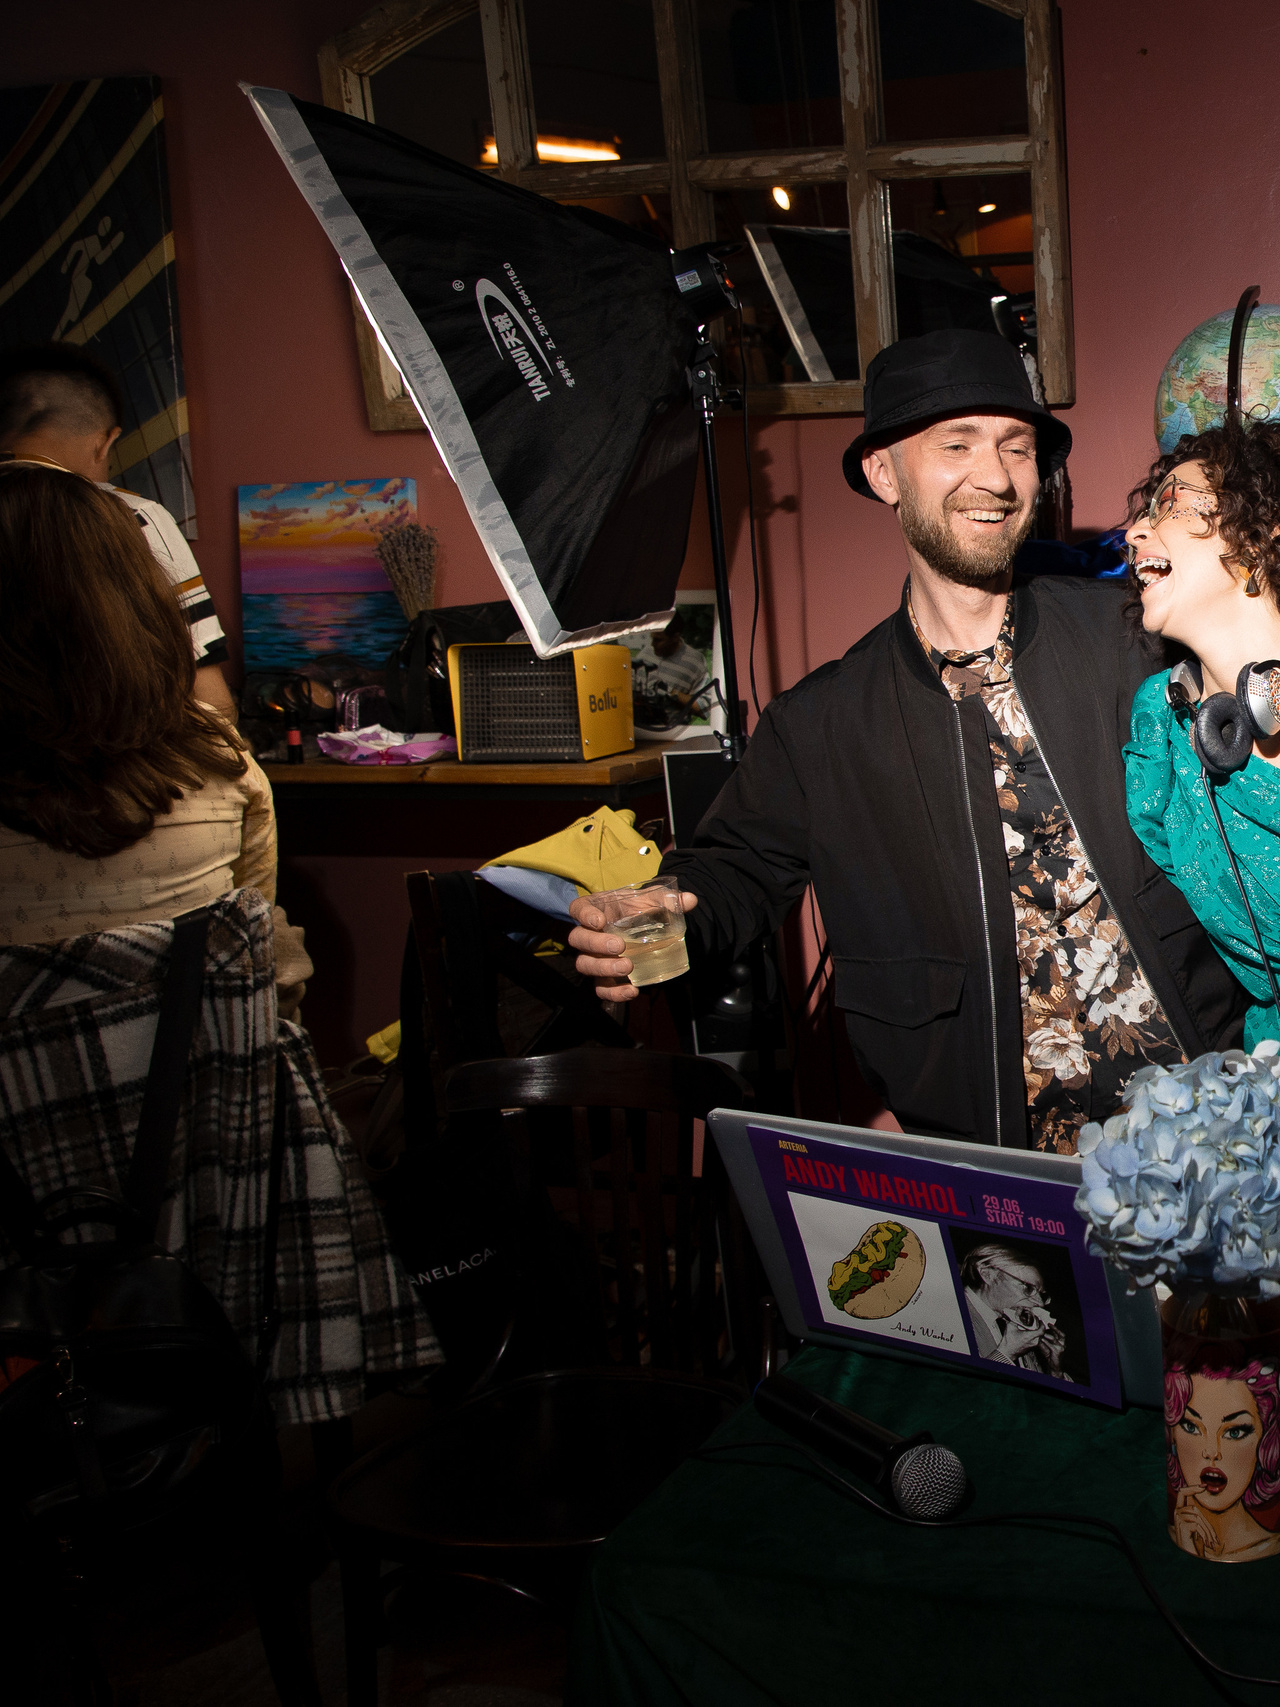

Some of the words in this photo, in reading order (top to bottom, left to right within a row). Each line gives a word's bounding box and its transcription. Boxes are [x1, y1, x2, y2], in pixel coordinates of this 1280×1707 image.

[532, 315, 549, 337] 2010
[588, 687, 618, 713] Ballu
[778, 1139, 808, 1154] ARTERIA
[782, 1154, 846, 1193] ANDY
[852, 1168, 967, 1217] WARHOL
[982, 1194, 1024, 1214] 29.06.
[985, 1208, 1024, 1228] START
[1028, 1216, 1065, 1236] 19:00
[890, 1322, 916, 1336] Andy
[920, 1327, 954, 1343] Warhol
